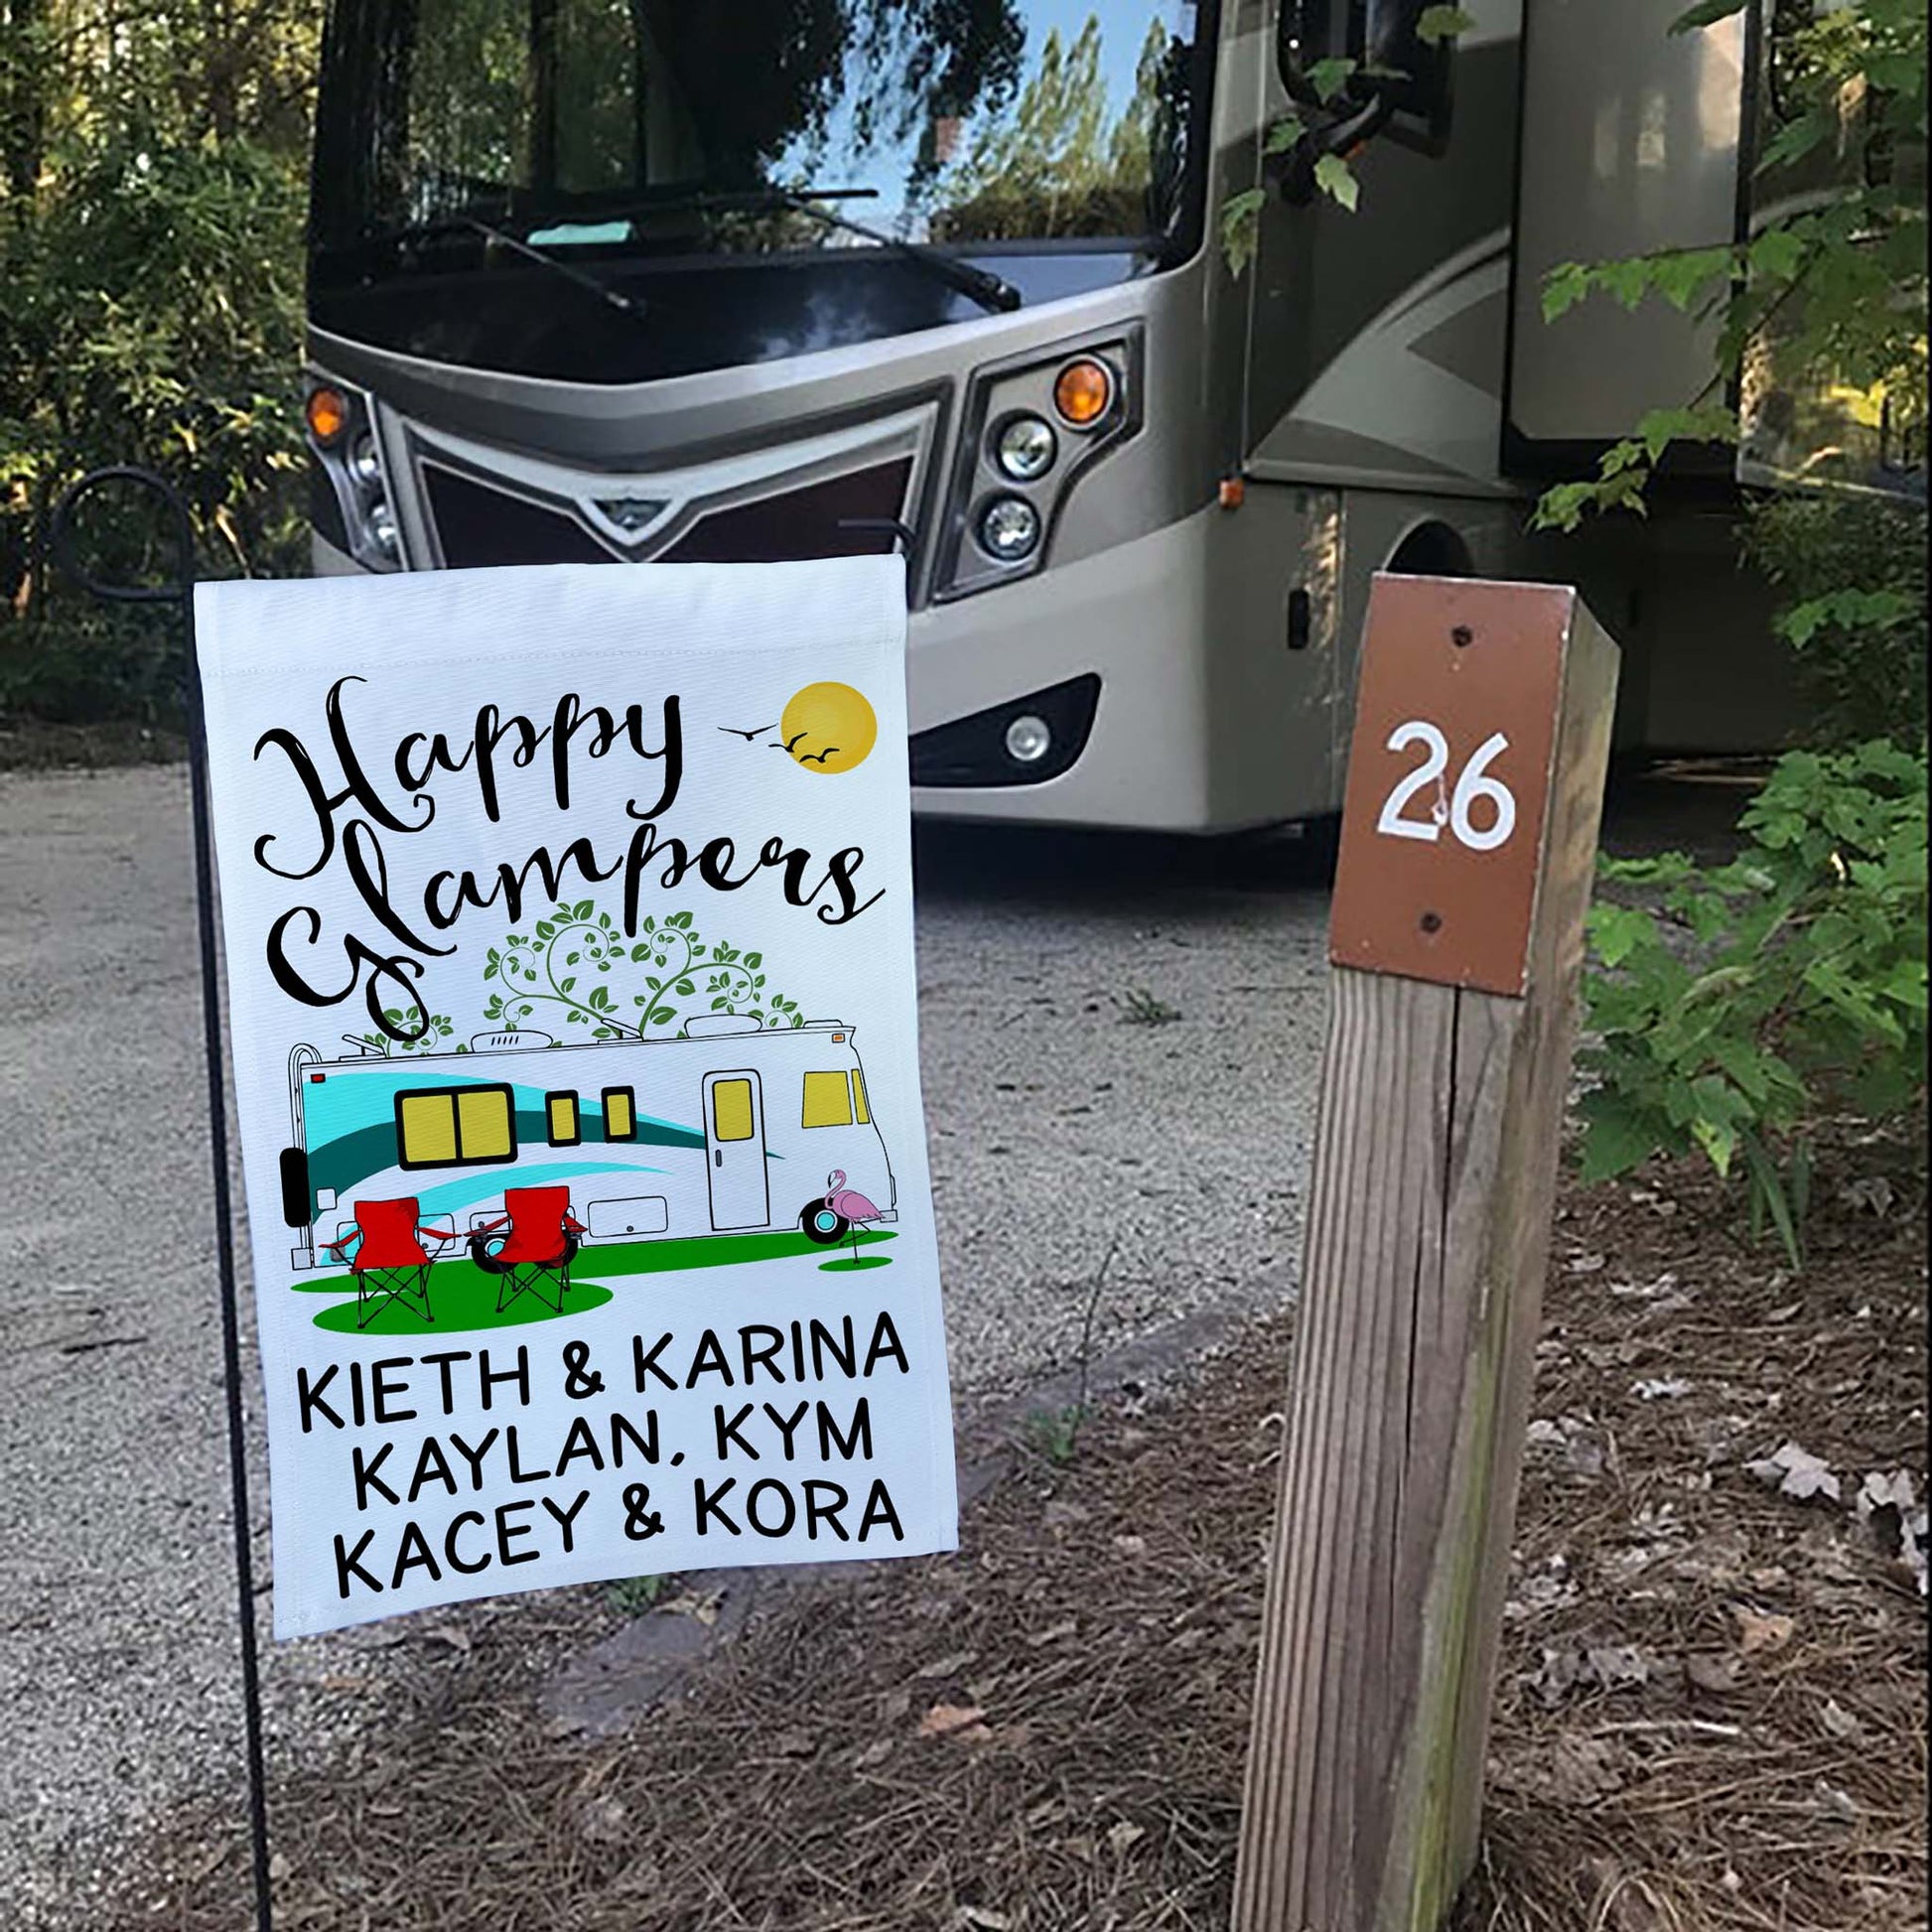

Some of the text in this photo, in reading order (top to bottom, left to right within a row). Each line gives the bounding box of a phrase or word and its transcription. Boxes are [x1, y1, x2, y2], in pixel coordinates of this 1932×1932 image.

[253, 675, 683, 880] Happy
[1377, 721, 1516, 851] 26
[266, 819, 887, 1042] Glampers
[296, 1311, 909, 1434] KIETH & KARINA
[714, 1397, 874, 1462] KYM
[334, 1478, 904, 1598] KACEY & KORA
